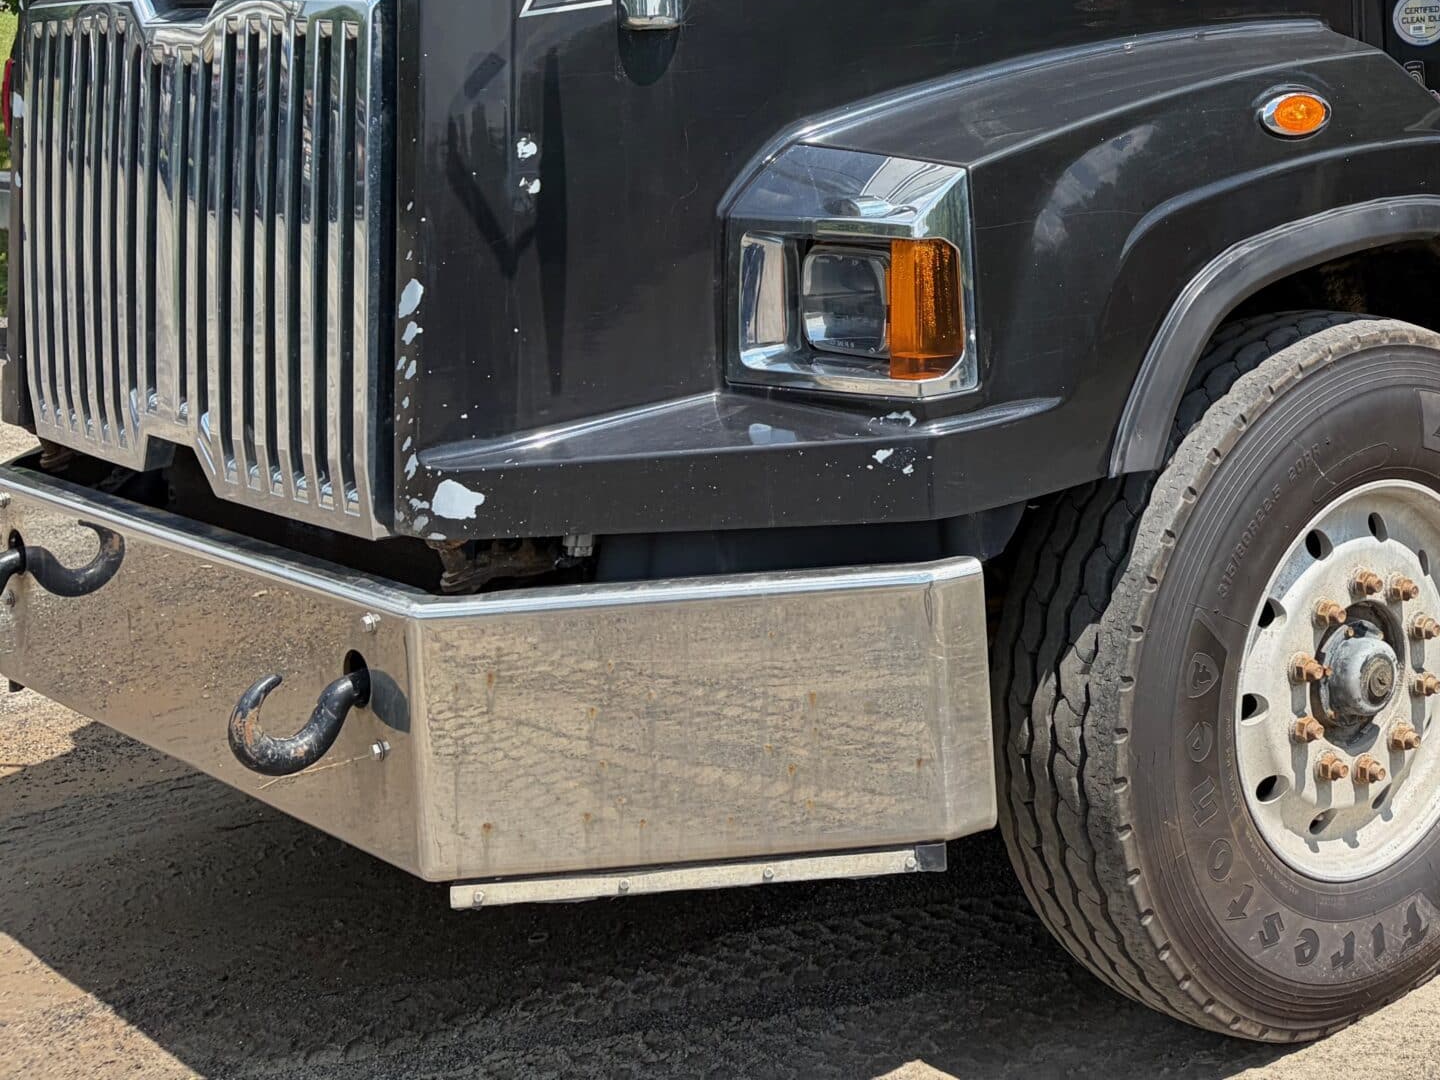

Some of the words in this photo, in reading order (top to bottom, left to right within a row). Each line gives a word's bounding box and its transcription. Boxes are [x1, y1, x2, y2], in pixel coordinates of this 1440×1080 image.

[1404, 5, 1440, 15] CERTIFIED
[1401, 14, 1425, 25] CLEAN
[1184, 720, 1430, 968] Firestone
